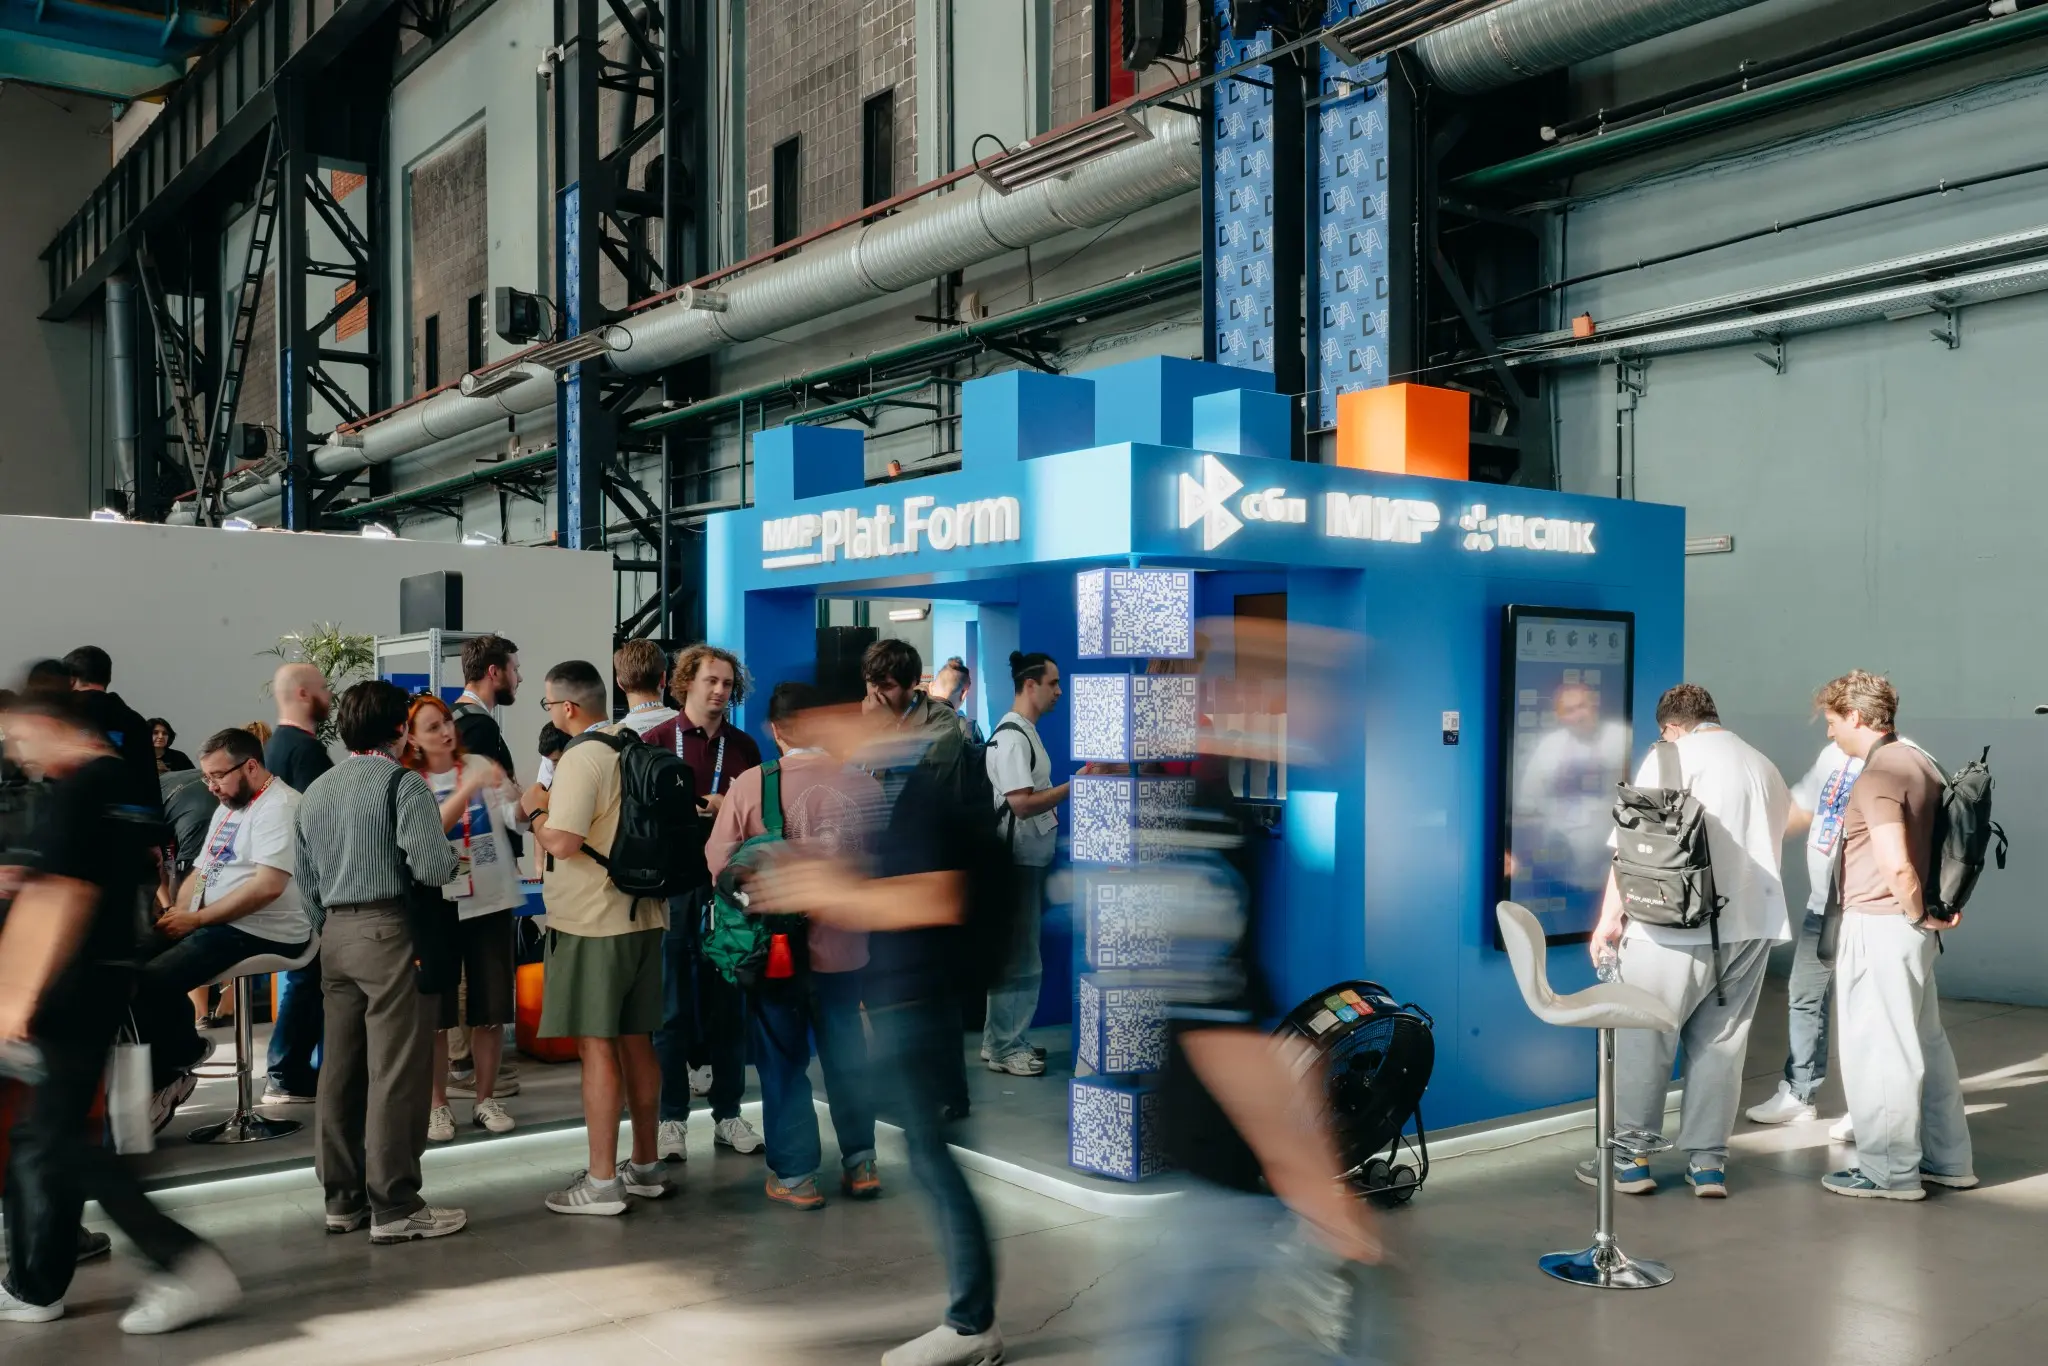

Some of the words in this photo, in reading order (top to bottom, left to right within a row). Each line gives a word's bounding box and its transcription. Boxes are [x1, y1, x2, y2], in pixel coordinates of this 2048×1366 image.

[821, 495, 1020, 563] Plat.Form
[1326, 491, 1441, 544] МИР
[1497, 513, 1597, 554] НСПК
